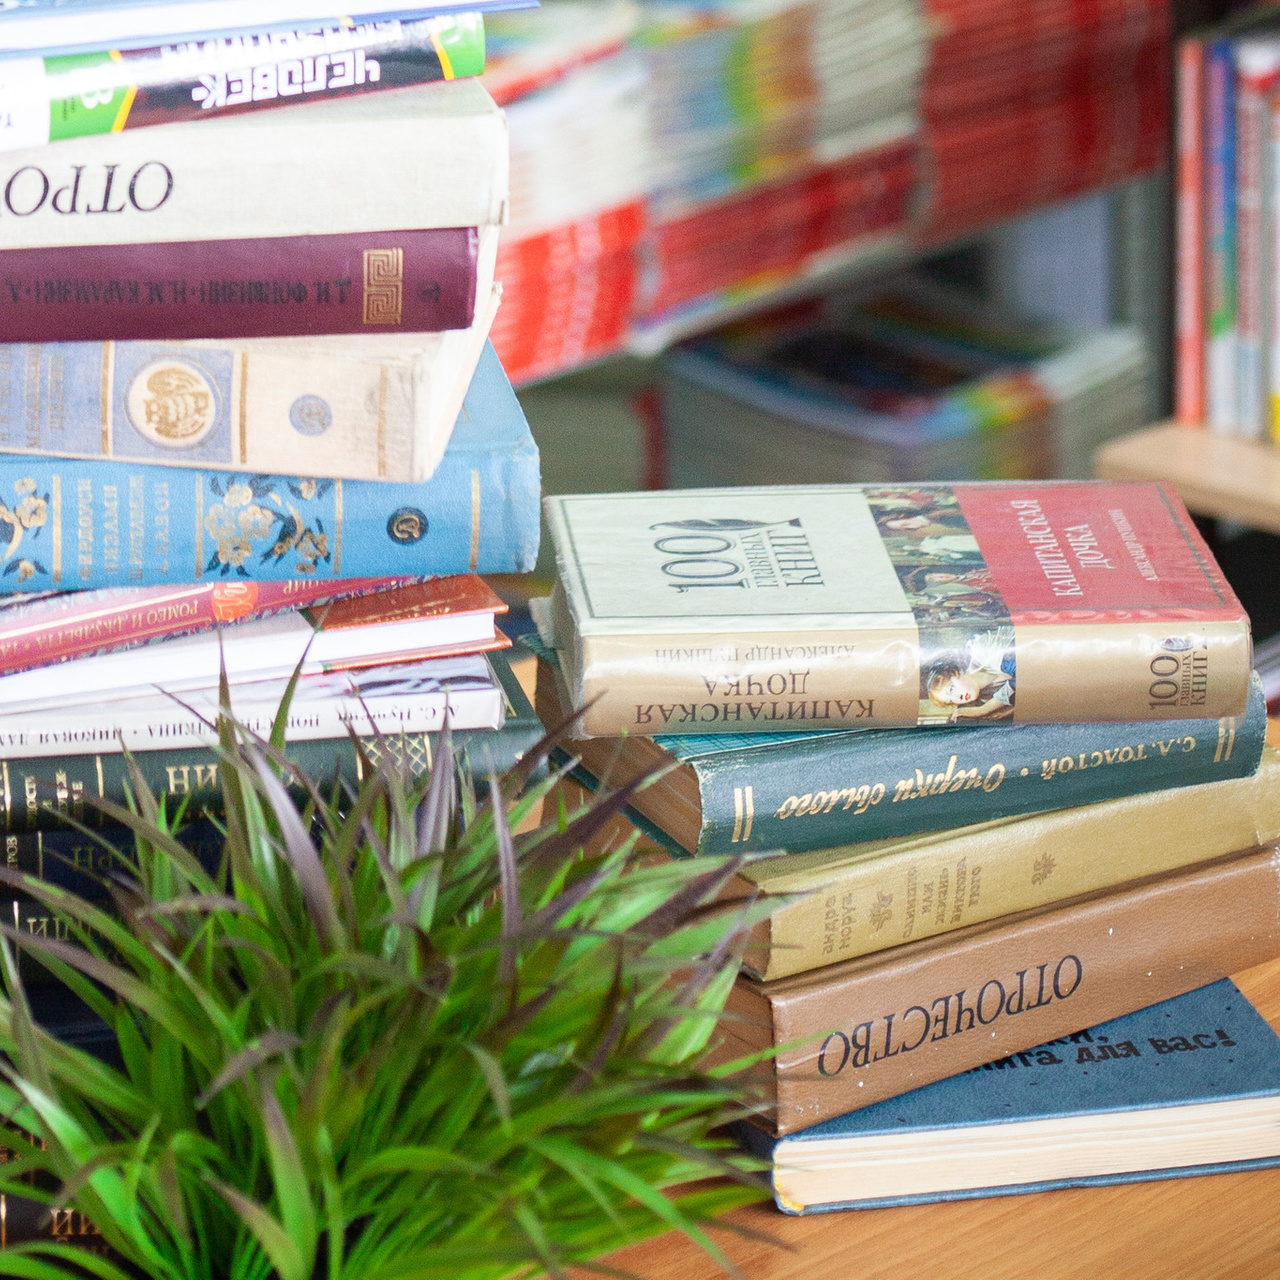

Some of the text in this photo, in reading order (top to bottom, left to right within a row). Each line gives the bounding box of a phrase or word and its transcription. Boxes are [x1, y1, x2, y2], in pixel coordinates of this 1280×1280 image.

[34, 278, 140, 305] КАРАМЗИН
[77, 478, 95, 581] ФИРДОУСИ
[103, 484, 119, 574] НИЗАМИ
[1013, 498, 1084, 597] КАПИТАНСКАЯ
[1064, 523, 1116, 570] ДОЧКА
[654, 534, 750, 593] 100
[1124, 540, 1159, 582] АЛЕКСАНДР
[130, 613, 145, 630] И
[146, 599, 199, 624] РОМЕО
[35, 614, 129, 650] ДЖУЛЬЕТТА
[746, 644, 856, 662] АЛЕКСАНДР
[700, 668, 811, 697] ДОЧКА
[1148, 654, 1182, 711] 100
[634, 698, 875, 725] КАПИТАНСКАЯ
[39, 725, 123, 744] ПИКОВАЯ
[892, 753, 1006, 794] Очерки
[1039, 743, 1149, 781] ТОЛСТОЙ
[773, 785, 885, 821] былого
[817, 954, 1083, 1078] ОТРОЧЕСТВО
[1075, 1040, 1142, 1065] для
[1147, 1028, 1238, 1055] вас!
